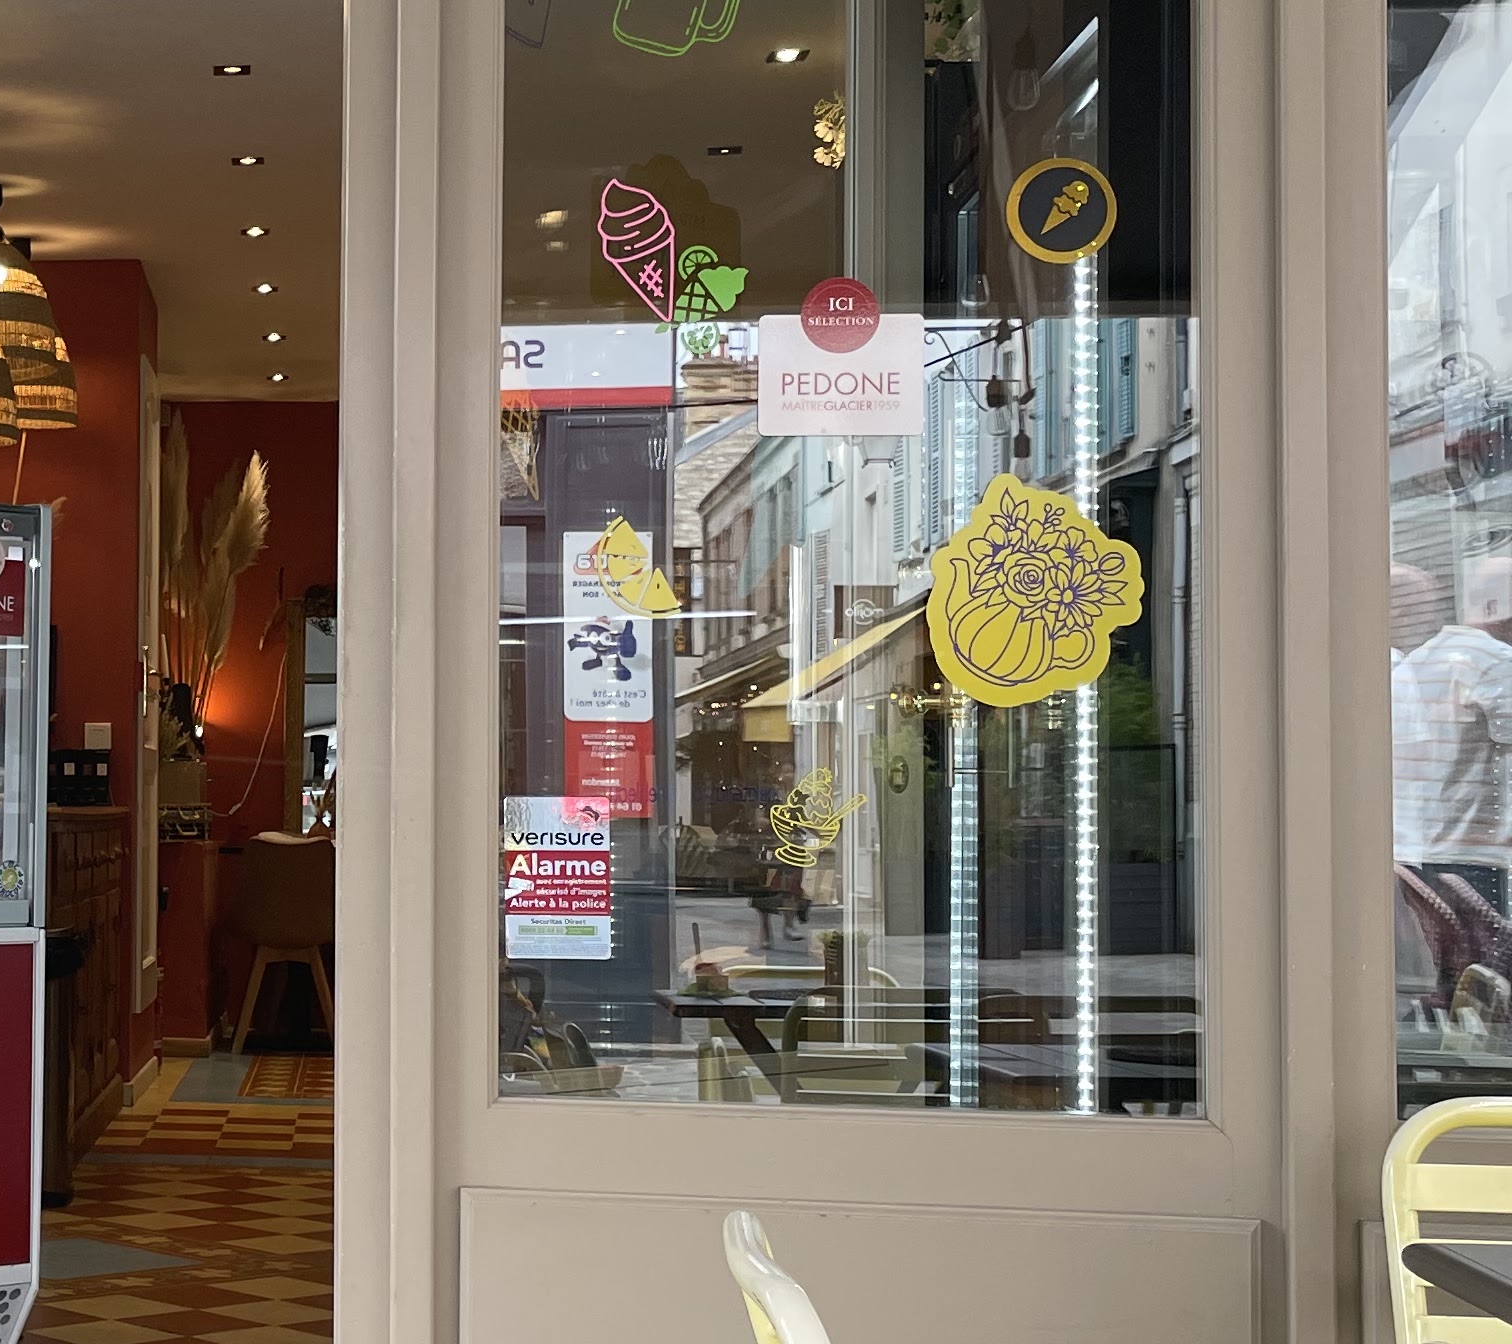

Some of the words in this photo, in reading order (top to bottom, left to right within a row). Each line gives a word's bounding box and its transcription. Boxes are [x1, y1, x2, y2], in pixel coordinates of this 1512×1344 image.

[829, 297, 854, 311] ICI
[808, 315, 875, 327] SÉLECTION
[782, 372, 901, 396] PEDONE
[511, 832, 604, 845] verisure
[509, 853, 607, 876] Alarme
[510, 898, 546, 908] Alerte
[550, 898, 558, 908] à
[559, 898, 569, 908] la
